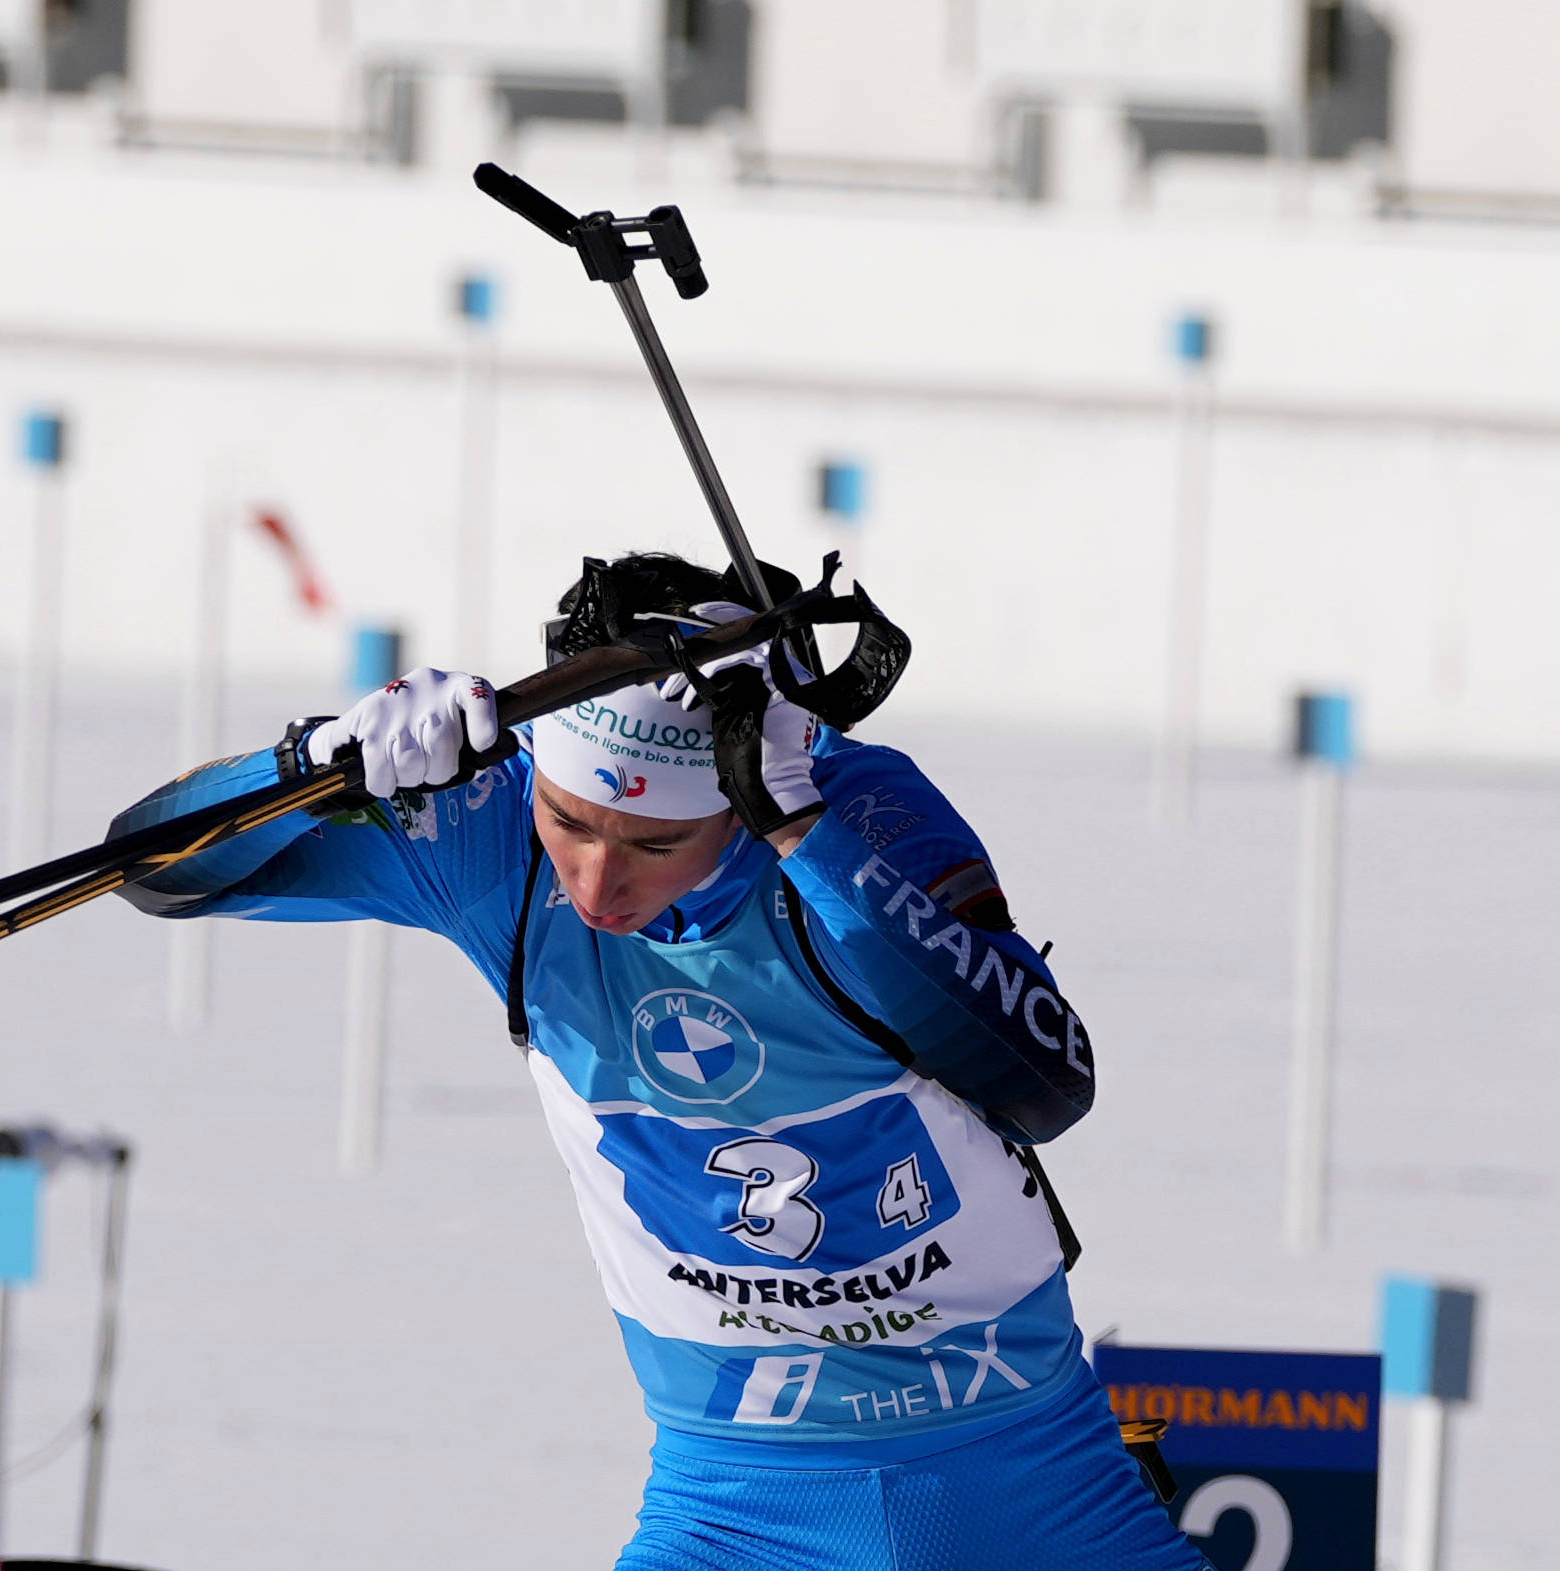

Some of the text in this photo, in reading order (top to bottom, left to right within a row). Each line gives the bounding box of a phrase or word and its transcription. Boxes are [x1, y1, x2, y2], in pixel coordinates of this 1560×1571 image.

[550, 710, 579, 733] urses
[581, 729, 599, 747] en
[601, 737, 641, 759] ligne
[644, 749, 670, 765] bio
[673, 755, 685, 766] &
[567, 699, 714, 751] enweez
[852, 853, 1091, 1078] FRANCE
[636, 995, 733, 1031] BMW
[704, 1135, 932, 1263] 3 4
[667, 1241, 952, 1309] ANTERSELVA
[841, 1383, 930, 1422] THE
